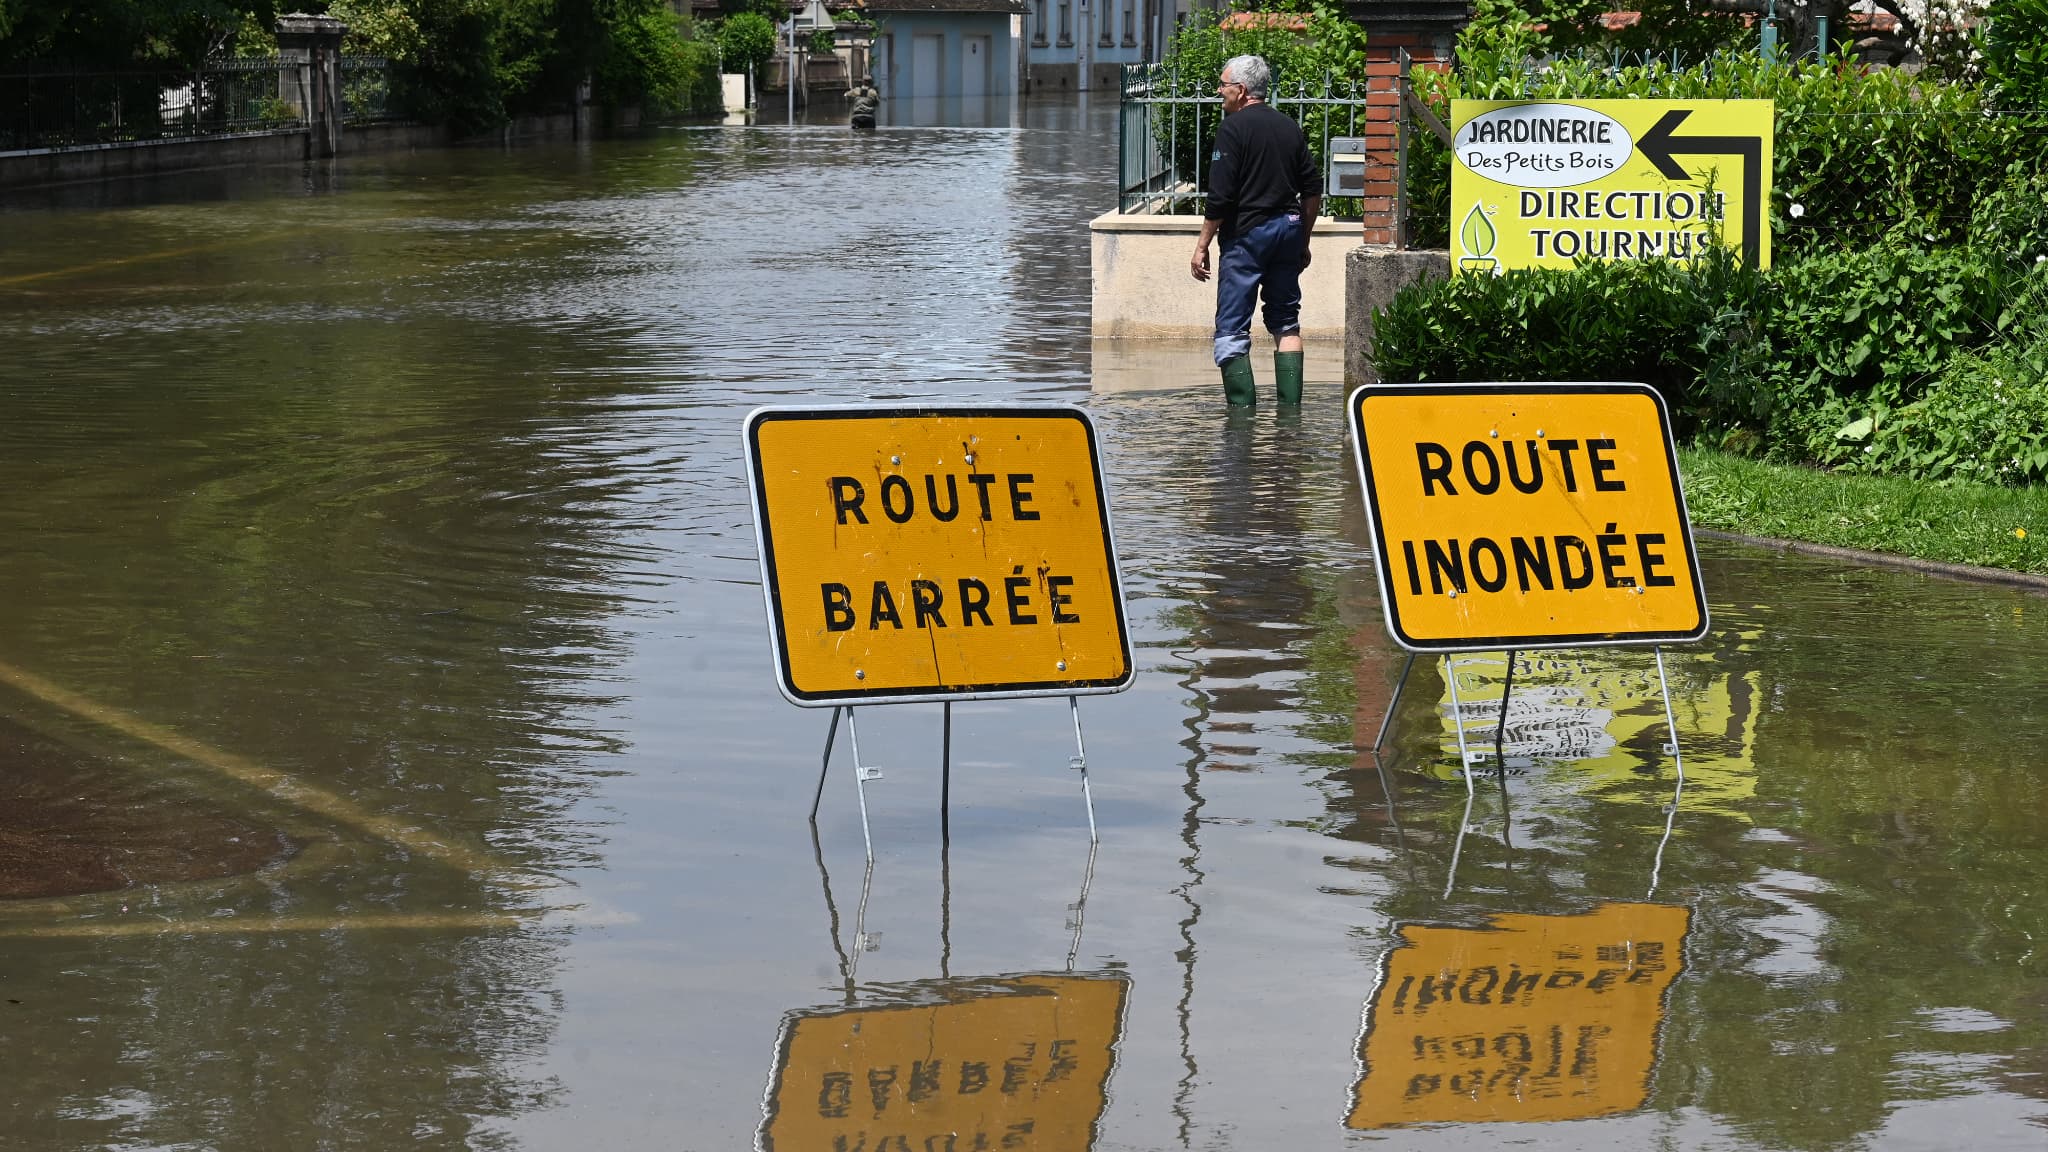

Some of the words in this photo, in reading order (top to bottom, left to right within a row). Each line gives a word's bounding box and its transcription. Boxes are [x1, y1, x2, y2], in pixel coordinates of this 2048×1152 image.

[1469, 119, 1612, 144] JARDINERIE
[1468, 152, 1502, 168] Des
[1504, 152, 1565, 173] Petits
[1570, 152, 1614, 168] Bois
[1520, 191, 1724, 219] DIRECTION
[1416, 439, 1626, 496] ROUTE
[831, 474, 1040, 525] ROUTE
[1402, 523, 1676, 595] INONDÉE
[821, 565, 1080, 632] BARRÉE
